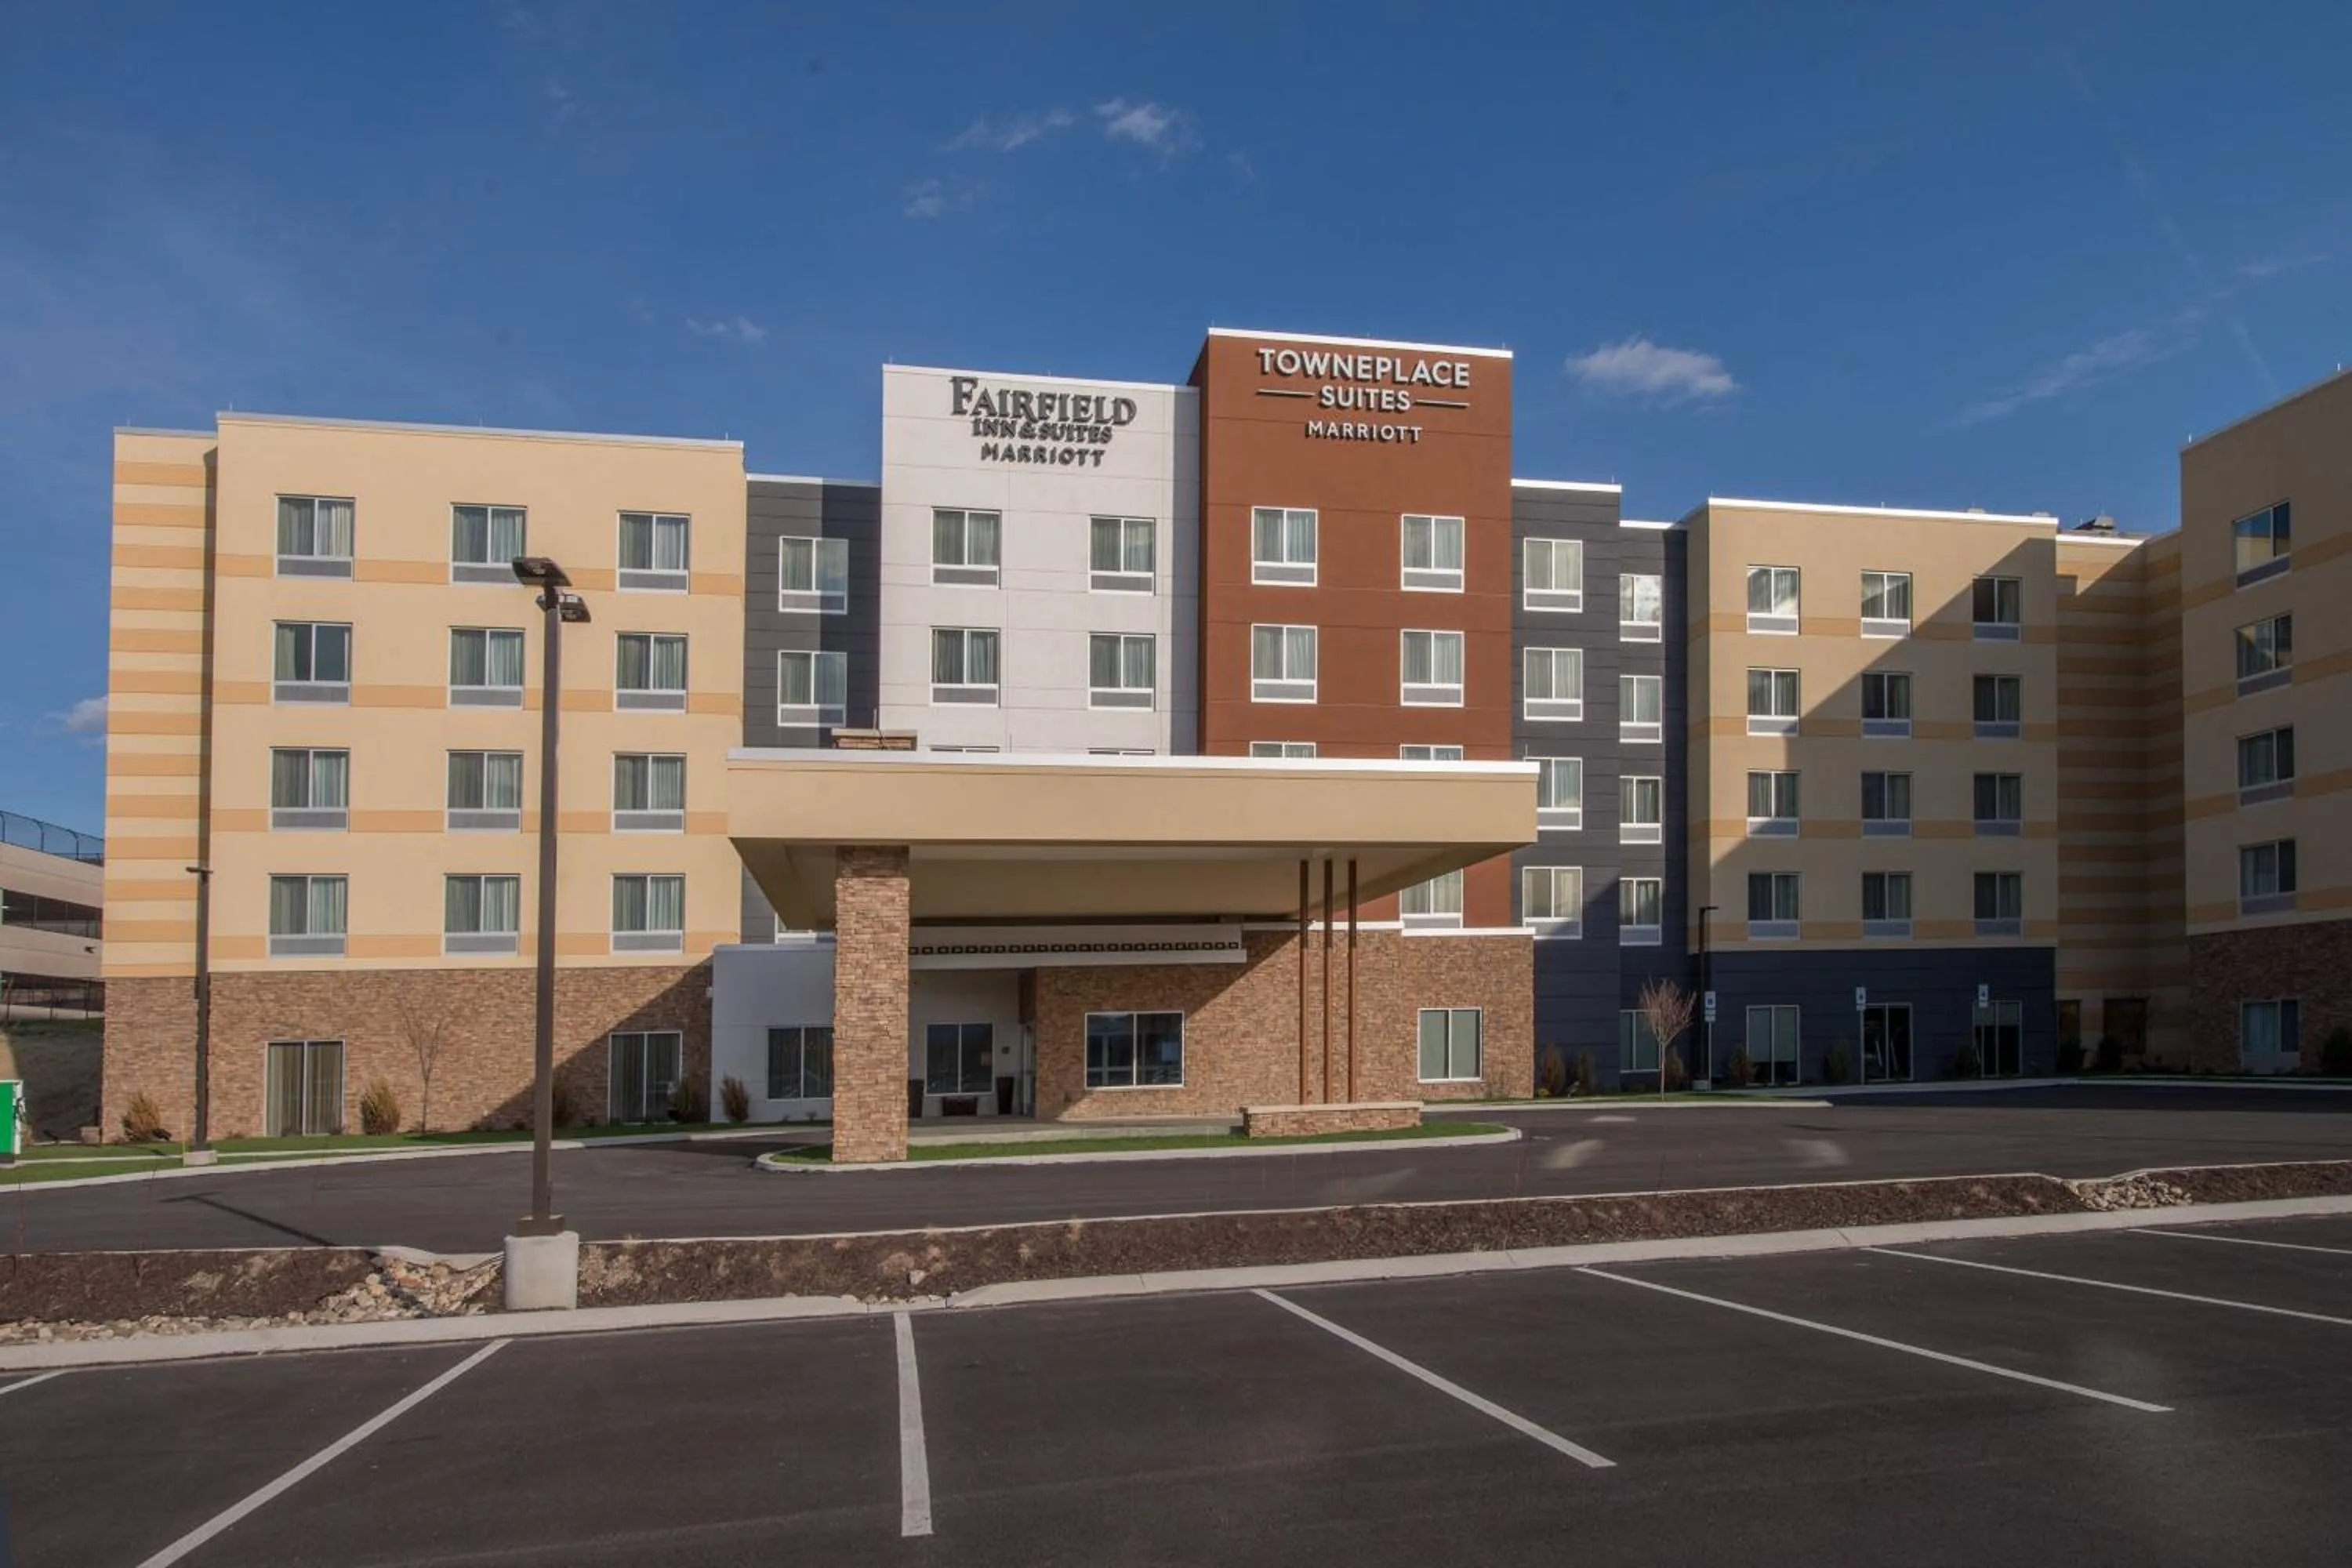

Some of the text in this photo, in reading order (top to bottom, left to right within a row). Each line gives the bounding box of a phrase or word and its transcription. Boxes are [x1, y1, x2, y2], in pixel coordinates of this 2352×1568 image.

[1258, 347, 1471, 386] TOWNEPLACE
[950, 376, 1137, 426] FAIRFIELD
[1319, 385, 1411, 411] SUITES
[1306, 420, 1423, 442] MARRIOTT
[981, 442, 1105, 467] MARRIOTT
